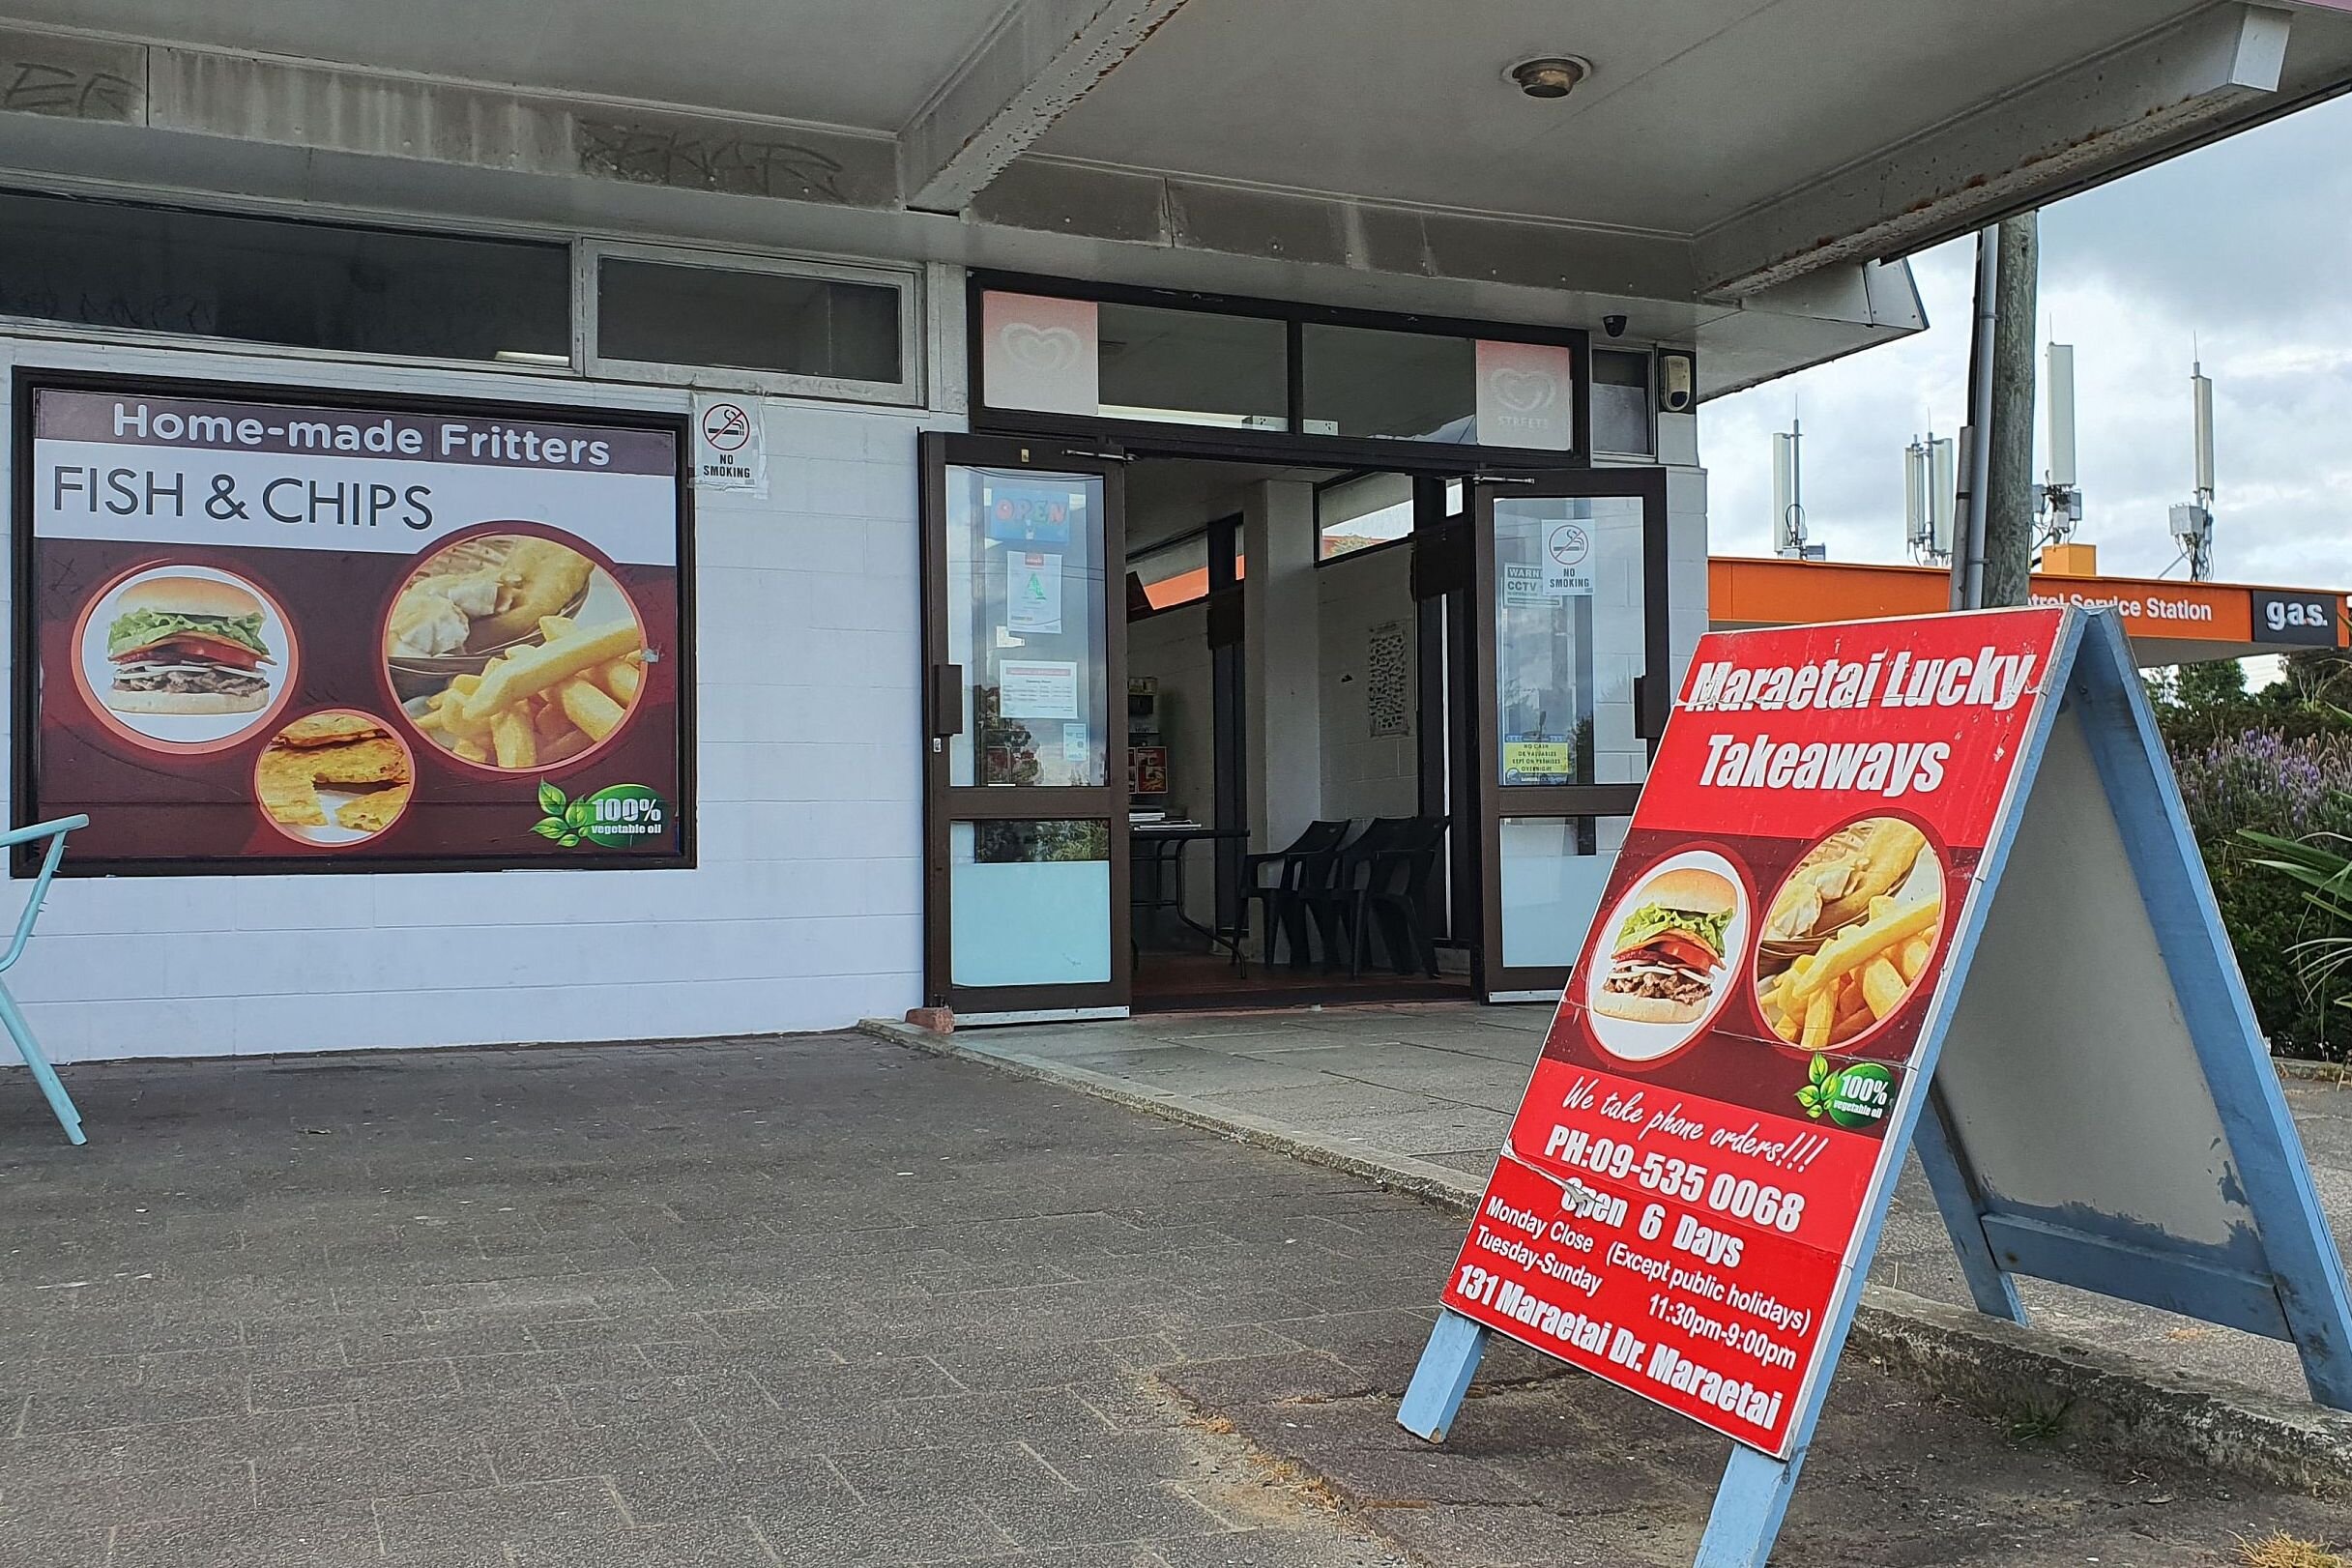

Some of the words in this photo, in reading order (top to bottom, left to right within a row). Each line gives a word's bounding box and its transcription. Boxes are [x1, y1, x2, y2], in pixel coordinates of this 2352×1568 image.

[113, 402, 422, 455] Home-made
[441, 423, 610, 466] Fritters
[703, 465, 750, 479] SMOKING
[719, 454, 734, 465] NO
[53, 465, 184, 517] FISH
[205, 473, 250, 521] &
[262, 477, 434, 531] CHIPS
[996, 498, 1067, 527] OPEN
[1507, 581, 1537, 592] CCTV
[1508, 568, 1542, 579] WARN
[1549, 578, 1590, 589] SMOKING
[1563, 567, 1576, 577] NO
[2146, 596, 2212, 622] Station
[1684, 648, 1888, 713] Maraetai
[1881, 646, 2038, 711] Lucky
[1699, 733, 1951, 798] Takeaways
[591, 824, 646, 835] vegetable
[647, 824, 662, 834] oil
[593, 798, 662, 823] 100%
[1833, 1099, 1872, 1117] vegetable
[1871, 1107, 1883, 1119] oil
[1840, 1074, 1889, 1106] 100%
[1562, 1075, 1599, 1110] We
[1600, 1090, 1644, 1124] take
[1637, 1102, 1704, 1142] phone
[1709, 1121, 1829, 1174] orders!!!
[1544, 1123, 1708, 1203] PH:09-535
[1708, 1172, 1806, 1234] 0068
[1485, 1195, 1548, 1241] Monday
[1550, 1220, 1594, 1254] Close
[1638, 1203, 1666, 1241] 6
[1671, 1213, 1745, 1269] Days
[1475, 1224, 1604, 1298] Tuesday-Sunday
[1605, 1240, 1671, 1283] (Except
[1667, 1266, 1727, 1302] public
[1726, 1282, 1812, 1338] holidays)
[1456, 1263, 1500, 1306] 131
[1494, 1279, 1613, 1355] Maraetai
[1607, 1326, 1648, 1373] Dr.
[1646, 1342, 1784, 1431] Maraetai
[1648, 1292, 1798, 1371] 11:30pm-9:00pm
